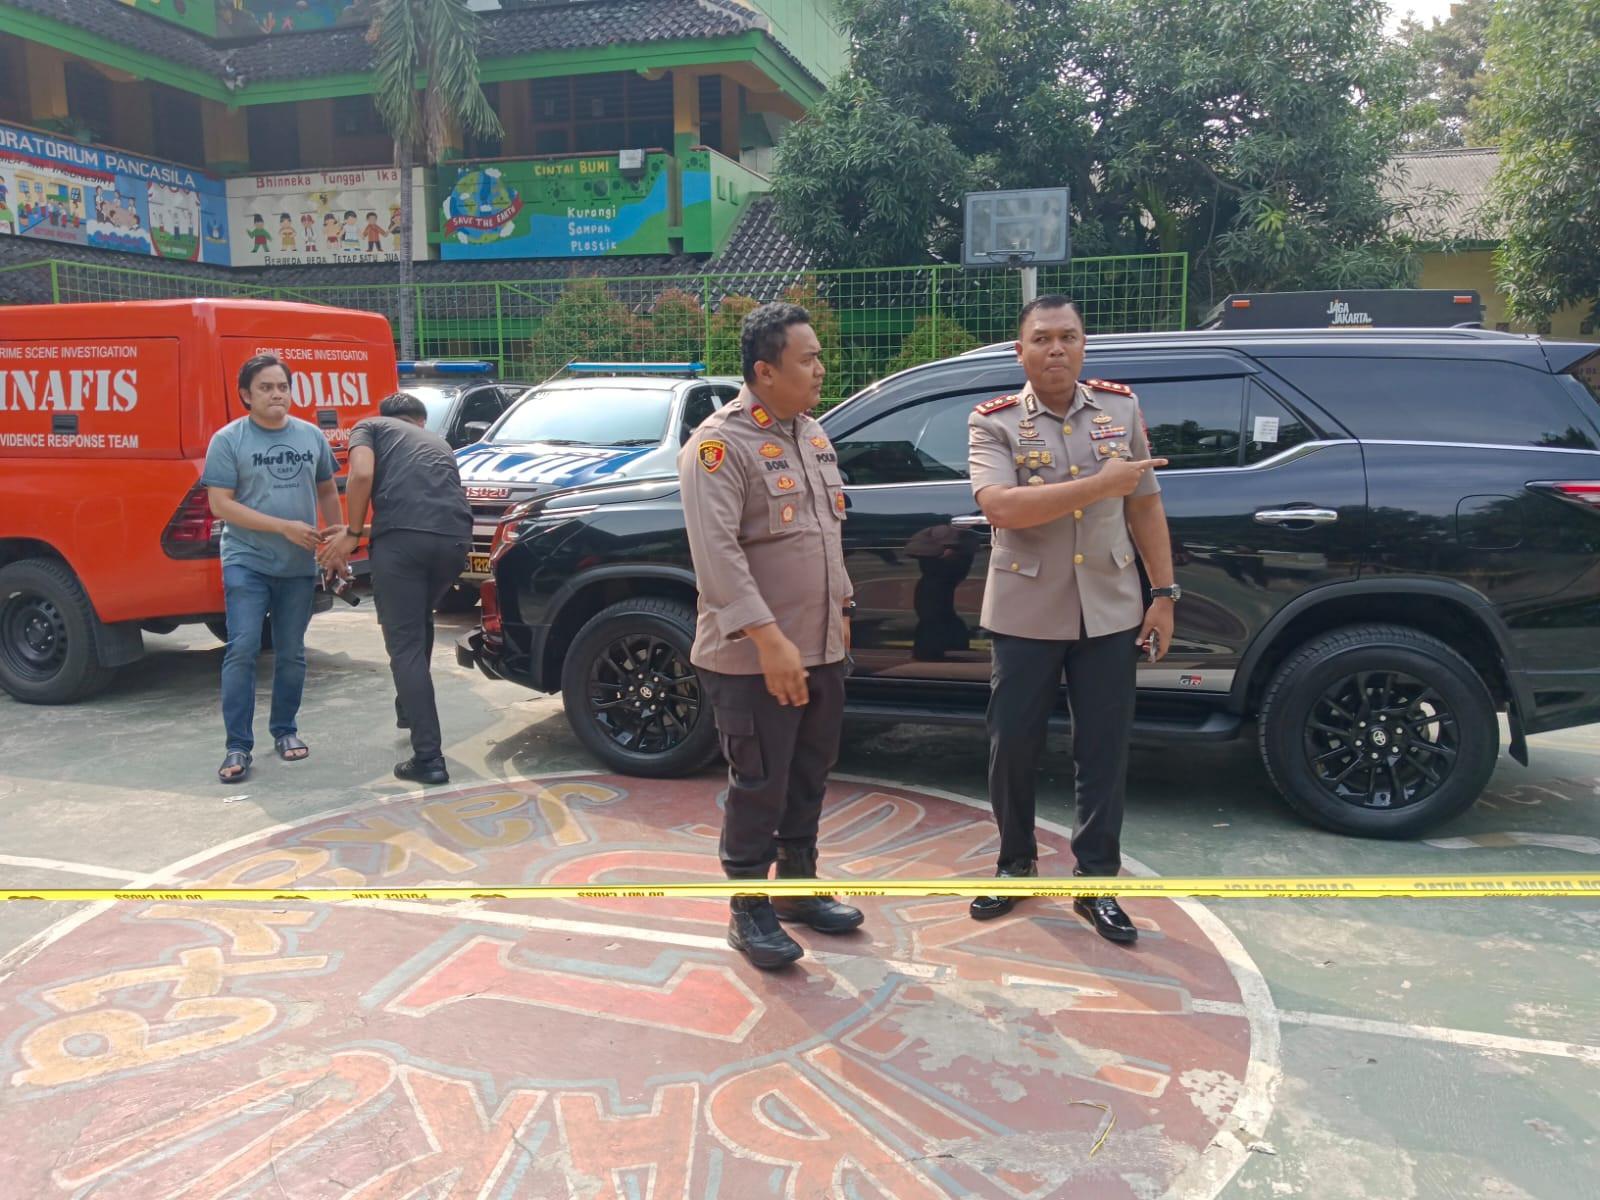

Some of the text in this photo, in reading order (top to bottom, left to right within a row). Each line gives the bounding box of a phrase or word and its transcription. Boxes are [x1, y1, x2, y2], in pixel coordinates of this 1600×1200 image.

[105, 154, 196, 188] PANCASILA
[580, 161, 609, 174] BUMI
[256, 169, 398, 189] Bhinneka Tunggal Ika
[567, 205, 616, 219] Kurangi
[453, 216, 474, 226] SAVE
[475, 218, 493, 228] THE
[1327, 301, 1349, 314] JAGA
[0, 346, 137, 359] RIME SCENE INVESTIGATION
[284, 349, 313, 361] SCENE
[314, 350, 368, 361] INVESTIGATION
[0, 368, 138, 412] INAFIS
[291, 371, 371, 408] OLISI
[0, 434, 139, 449] VIDENCE RESPONSE TEAM
[252, 450, 314, 467] Hard Rock
[466, 487, 509, 497] ISUZU
